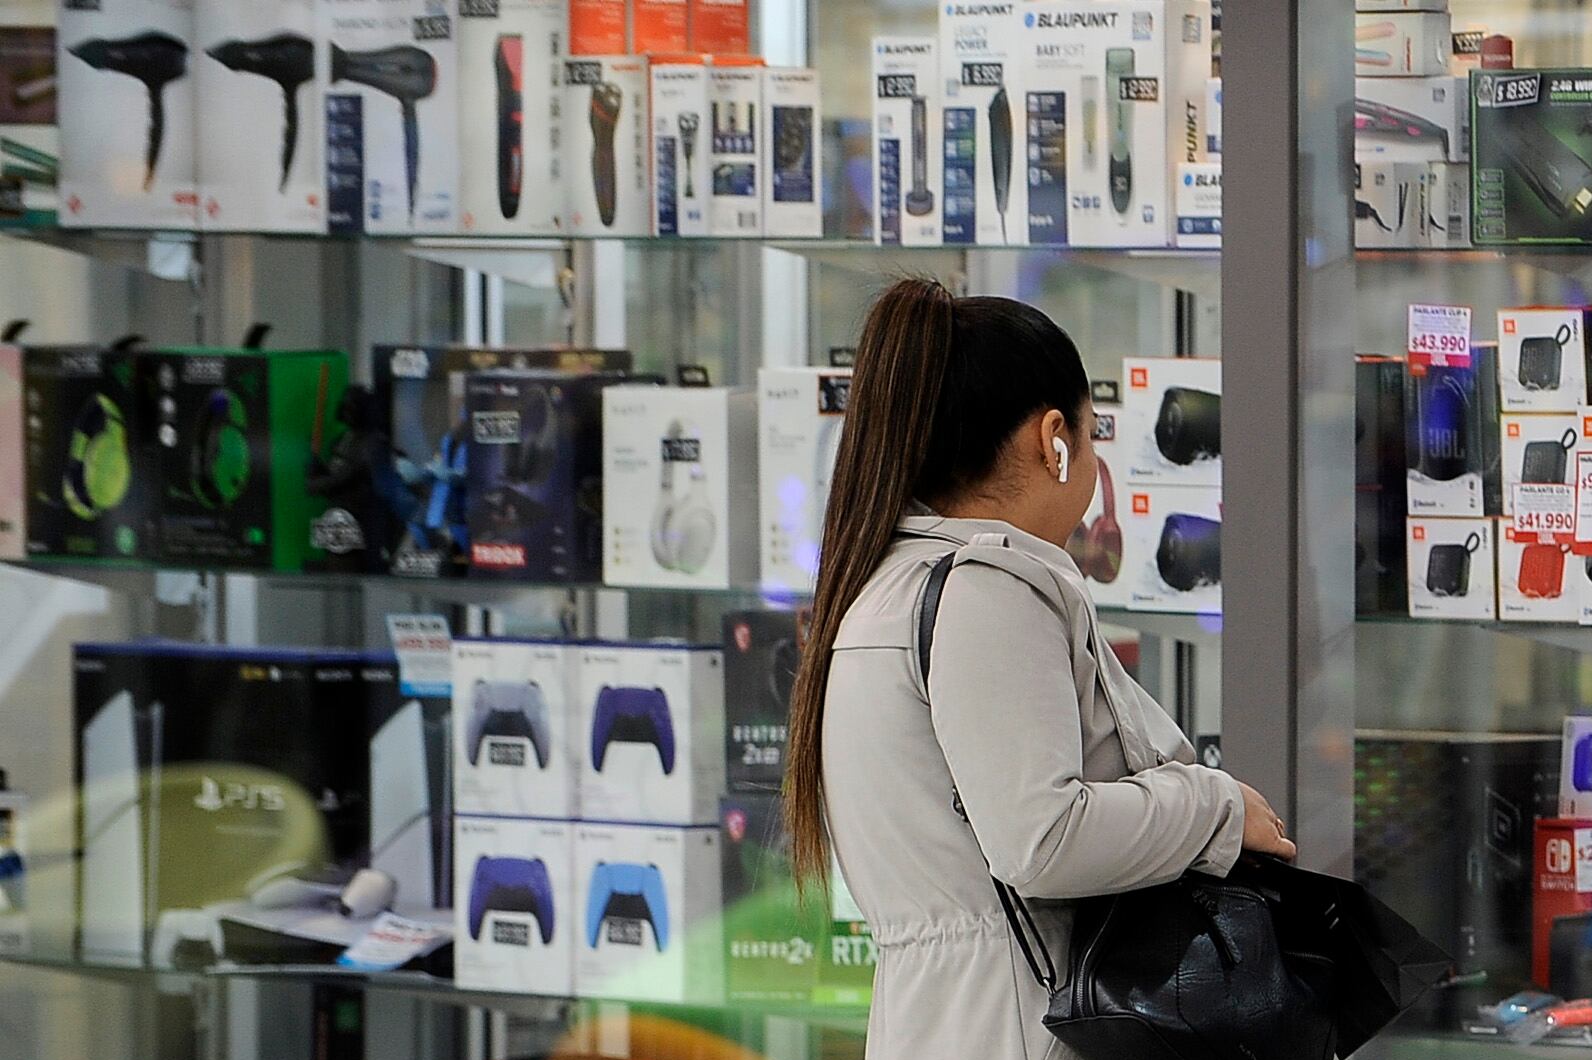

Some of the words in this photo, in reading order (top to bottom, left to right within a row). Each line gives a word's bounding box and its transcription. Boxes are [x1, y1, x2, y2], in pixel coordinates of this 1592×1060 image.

[955, 4, 1013, 16] BLAUPUNKT
[1037, 13, 1117, 28] BLAUPUNKT
[1413, 334, 1466, 351] $43.990
[1519, 513, 1573, 529] $41.990
[832, 936, 880, 967] RTX
